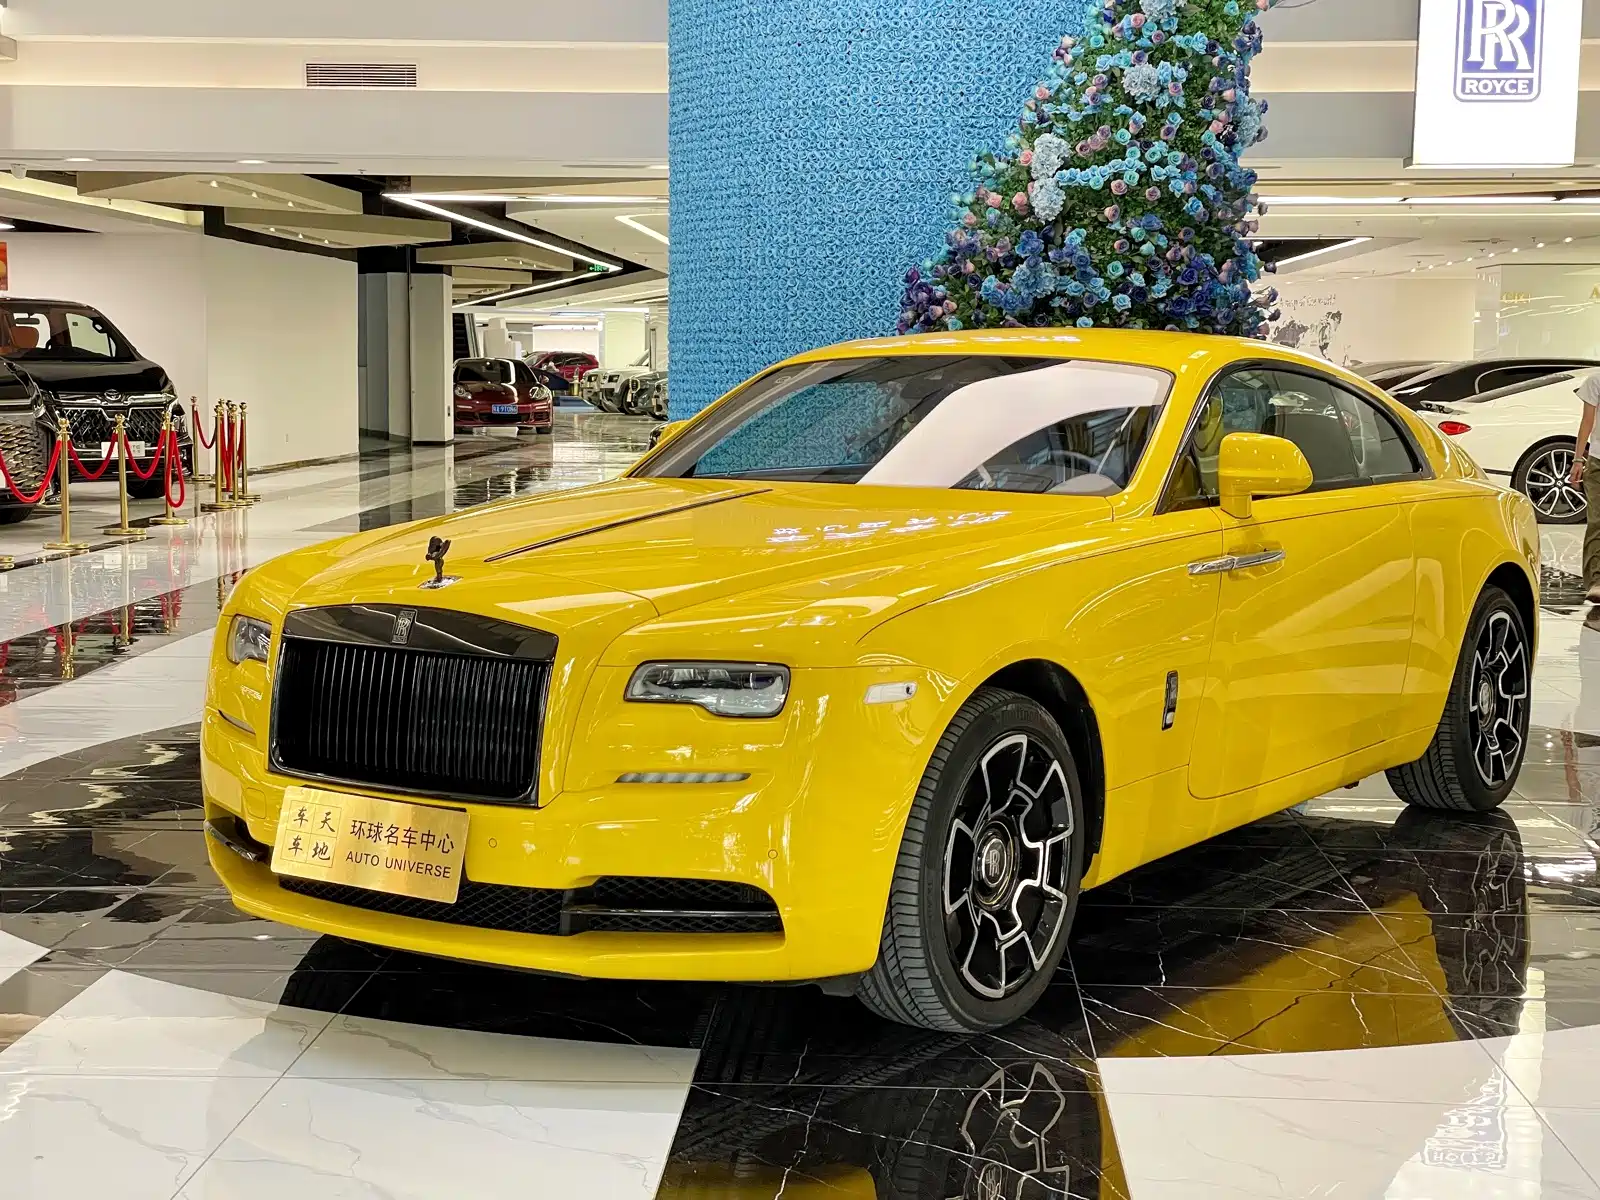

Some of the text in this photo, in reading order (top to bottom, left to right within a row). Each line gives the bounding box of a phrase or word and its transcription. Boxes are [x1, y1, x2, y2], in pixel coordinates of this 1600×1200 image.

[1464, 79, 1530, 94] ROYCE
[350, 819, 455, 854] 环球名车中心
[346, 851, 452, 879] AUTO UNIVERSE
